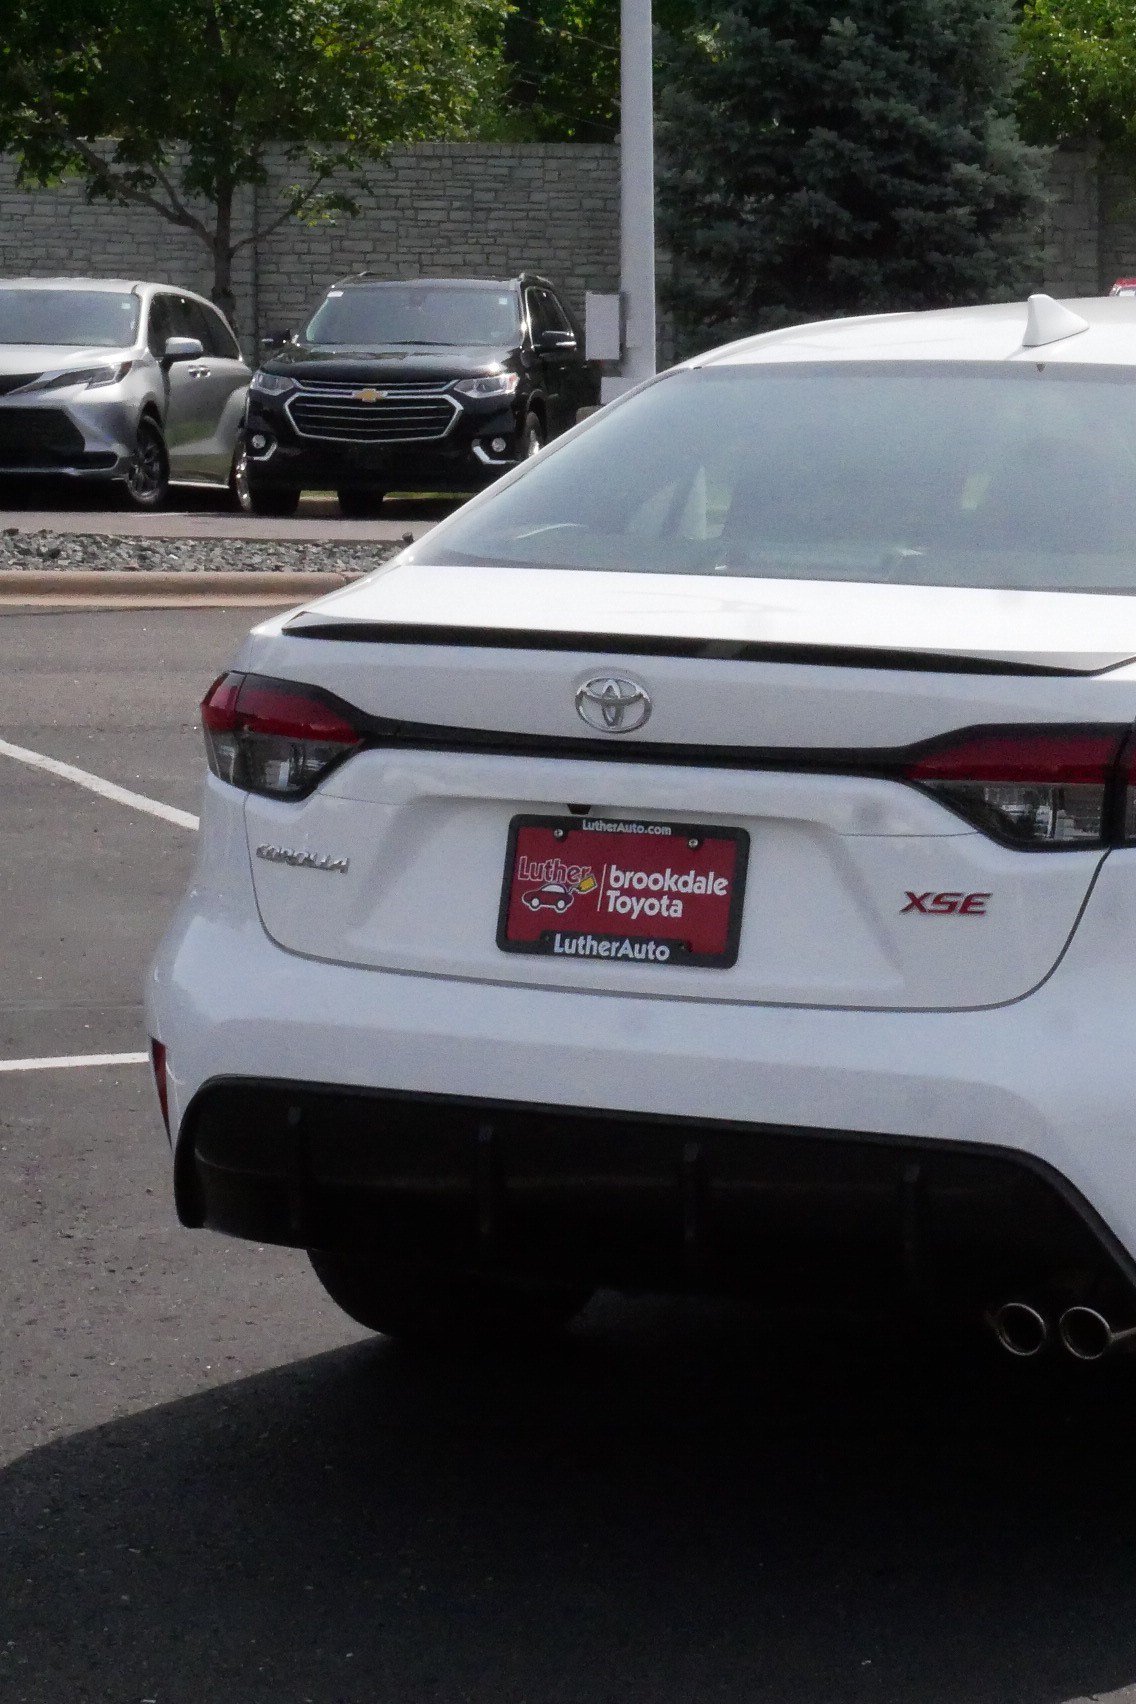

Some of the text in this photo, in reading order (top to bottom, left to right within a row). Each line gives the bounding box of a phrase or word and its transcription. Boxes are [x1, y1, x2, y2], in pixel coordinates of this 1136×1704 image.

[582, 819, 672, 836] LutherAuto.com
[517, 855, 592, 883] Luther
[609, 864, 729, 897] brookdale
[606, 889, 684, 920] Toyota
[899, 890, 993, 915] XSE
[553, 932, 671, 961] LutherAuto
